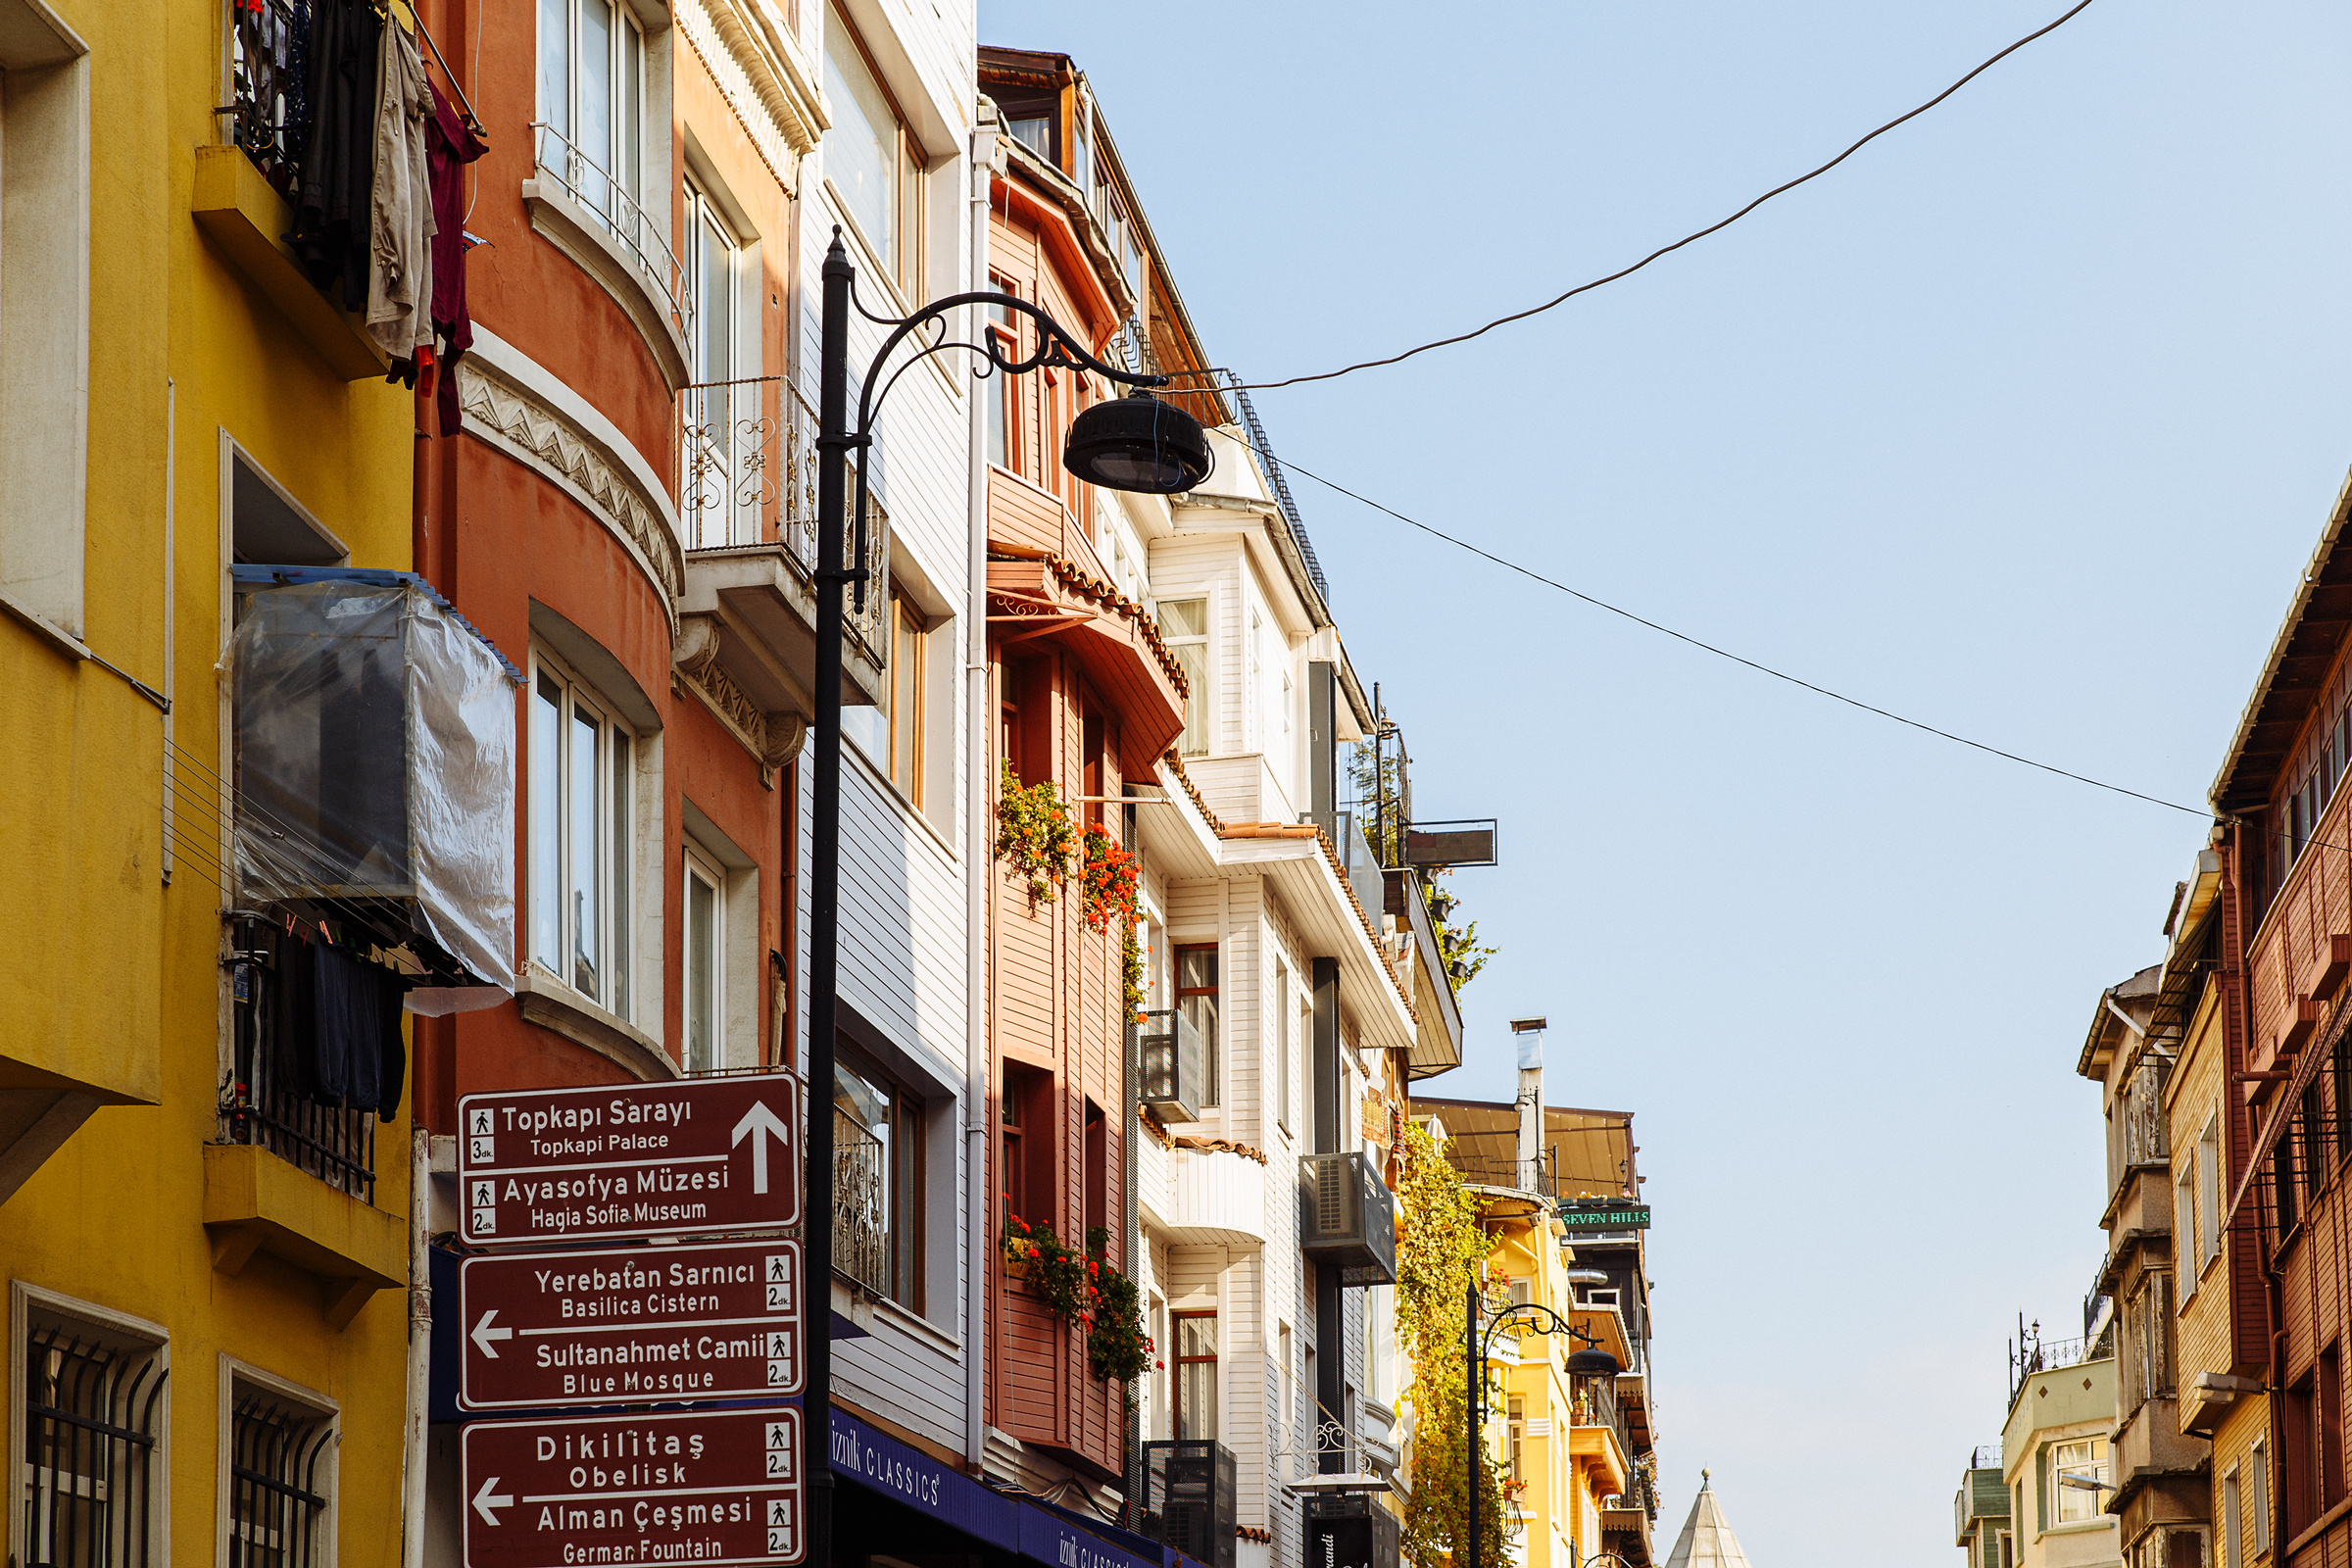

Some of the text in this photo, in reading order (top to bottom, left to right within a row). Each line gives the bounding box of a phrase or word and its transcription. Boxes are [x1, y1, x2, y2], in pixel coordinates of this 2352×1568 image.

[502, 1100, 691, 1136] Topkapı Sarayı
[530, 1133, 668, 1158] Topkapi Palace
[503, 1164, 728, 1206] Ayasofya Müzesi
[531, 1201, 707, 1234] Hagia Sofia Museum
[1562, 1211, 1649, 1225] SEVEN HILLS
[534, 1262, 755, 1294] Yerebatan Sarnıcı
[562, 1293, 719, 1318] Basilica Cistern
[536, 1333, 764, 1368] Sultanahmet Camii
[564, 1371, 713, 1395] Blue Mosque
[537, 1429, 705, 1461] Dikilitaş
[569, 1461, 686, 1489] Obelisk
[537, 1495, 751, 1533] Alman Çeşmesi
[564, 1538, 722, 1564] German Fountain
